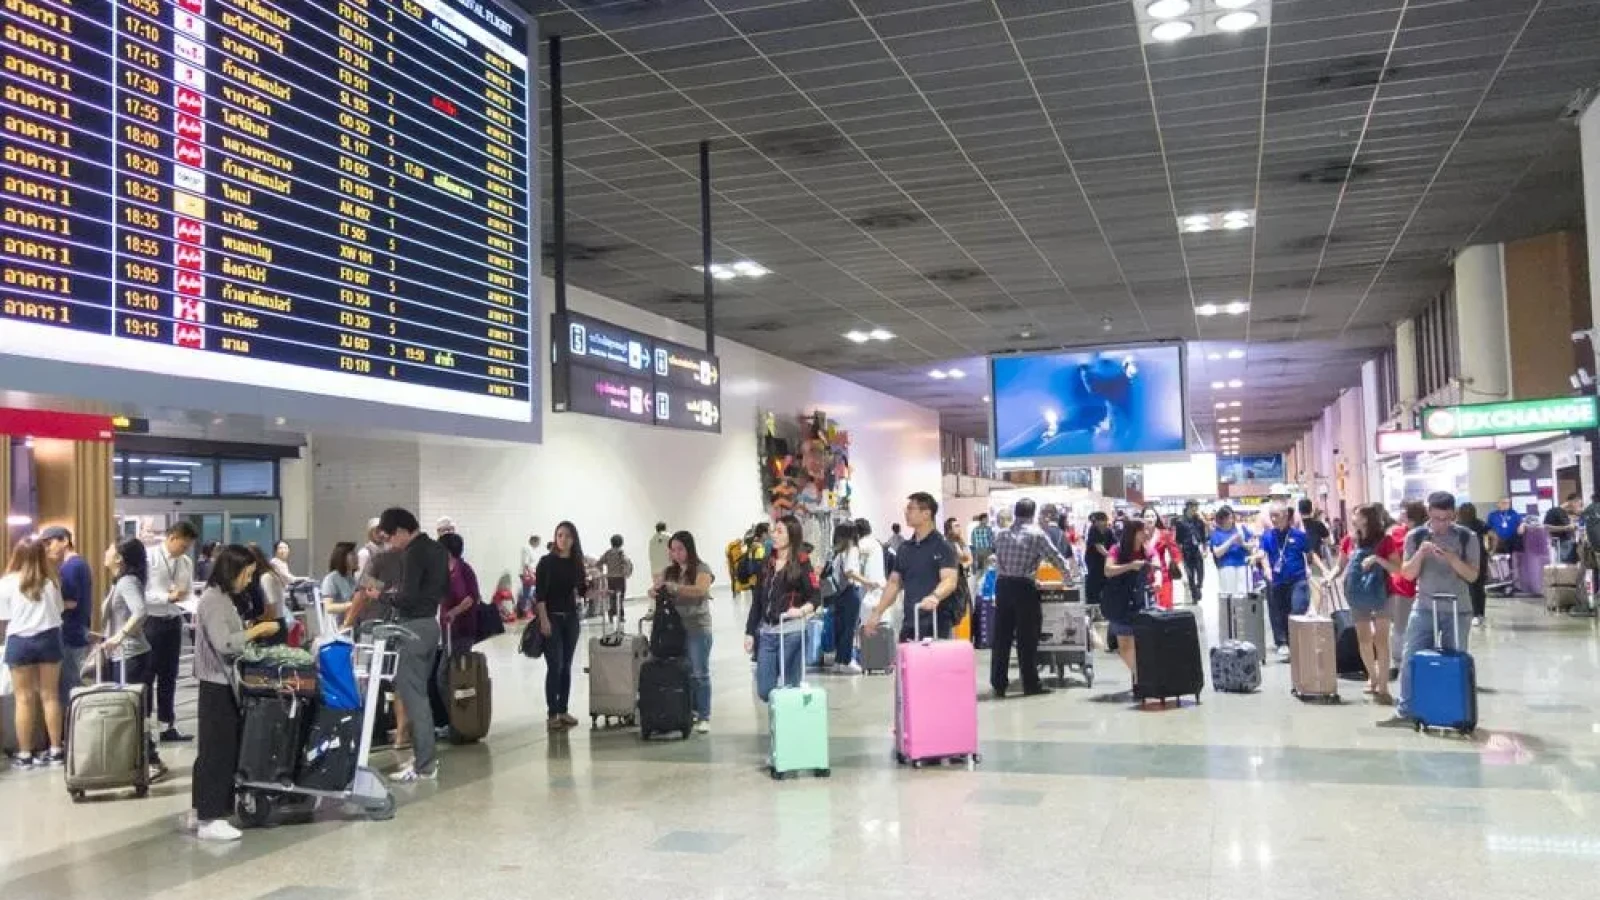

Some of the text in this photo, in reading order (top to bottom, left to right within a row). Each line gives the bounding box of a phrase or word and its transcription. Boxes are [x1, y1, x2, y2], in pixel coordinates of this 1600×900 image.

[338, 3, 353, 20] FD
[60, 16, 71, 32] 1
[125, 16, 160, 42] 17:10
[4, 24, 71, 61] อาคาร 1
[125, 44, 160, 69] 17:15
[338, 47, 352, 62] FD
[4, 54, 71, 91] อาคาร 1
[338, 70, 352, 84] FD
[125, 71, 160, 94] 17:30
[4, 84, 71, 119] อาคาร 1
[340, 91, 352, 106] SL
[125, 98, 160, 122] 17:55
[339, 113, 353, 129] OD
[4, 115, 71, 147] อาคาร 1
[125, 125, 160, 149] 18:00
[340, 134, 352, 151] SL
[4, 144, 71, 177] อาคาร 1
[125, 152, 160, 175] 18:20
[339, 157, 353, 172] FD
[4, 175, 71, 206] อาคาร 1
[125, 180, 160, 202] 18:25
[339, 179, 353, 194] FD
[388, 176, 395, 188] 2
[125, 207, 160, 229] 18:35
[339, 201, 353, 216] AK
[4, 208, 71, 235] อาคาร 1
[340, 222, 350, 235] IT
[4, 237, 71, 264] อาคาร 1
[125, 235, 160, 256] 18:55
[340, 245, 356, 259] XW
[389, 239, 395, 250] 5
[4, 269, 71, 293] อาคาร 1
[125, 263, 160, 283] 19:05
[340, 267, 353, 281] FD
[340, 289, 353, 303] FD
[389, 281, 395, 292] 5
[125, 291, 160, 310] 19:10
[4, 299, 71, 323] อาคาร 1
[340, 313, 353, 326] FD
[125, 318, 160, 337] 19:15
[340, 335, 352, 348] XJ
[340, 357, 353, 369] FD
[1460, 404, 1592, 428] EXCHANGE
